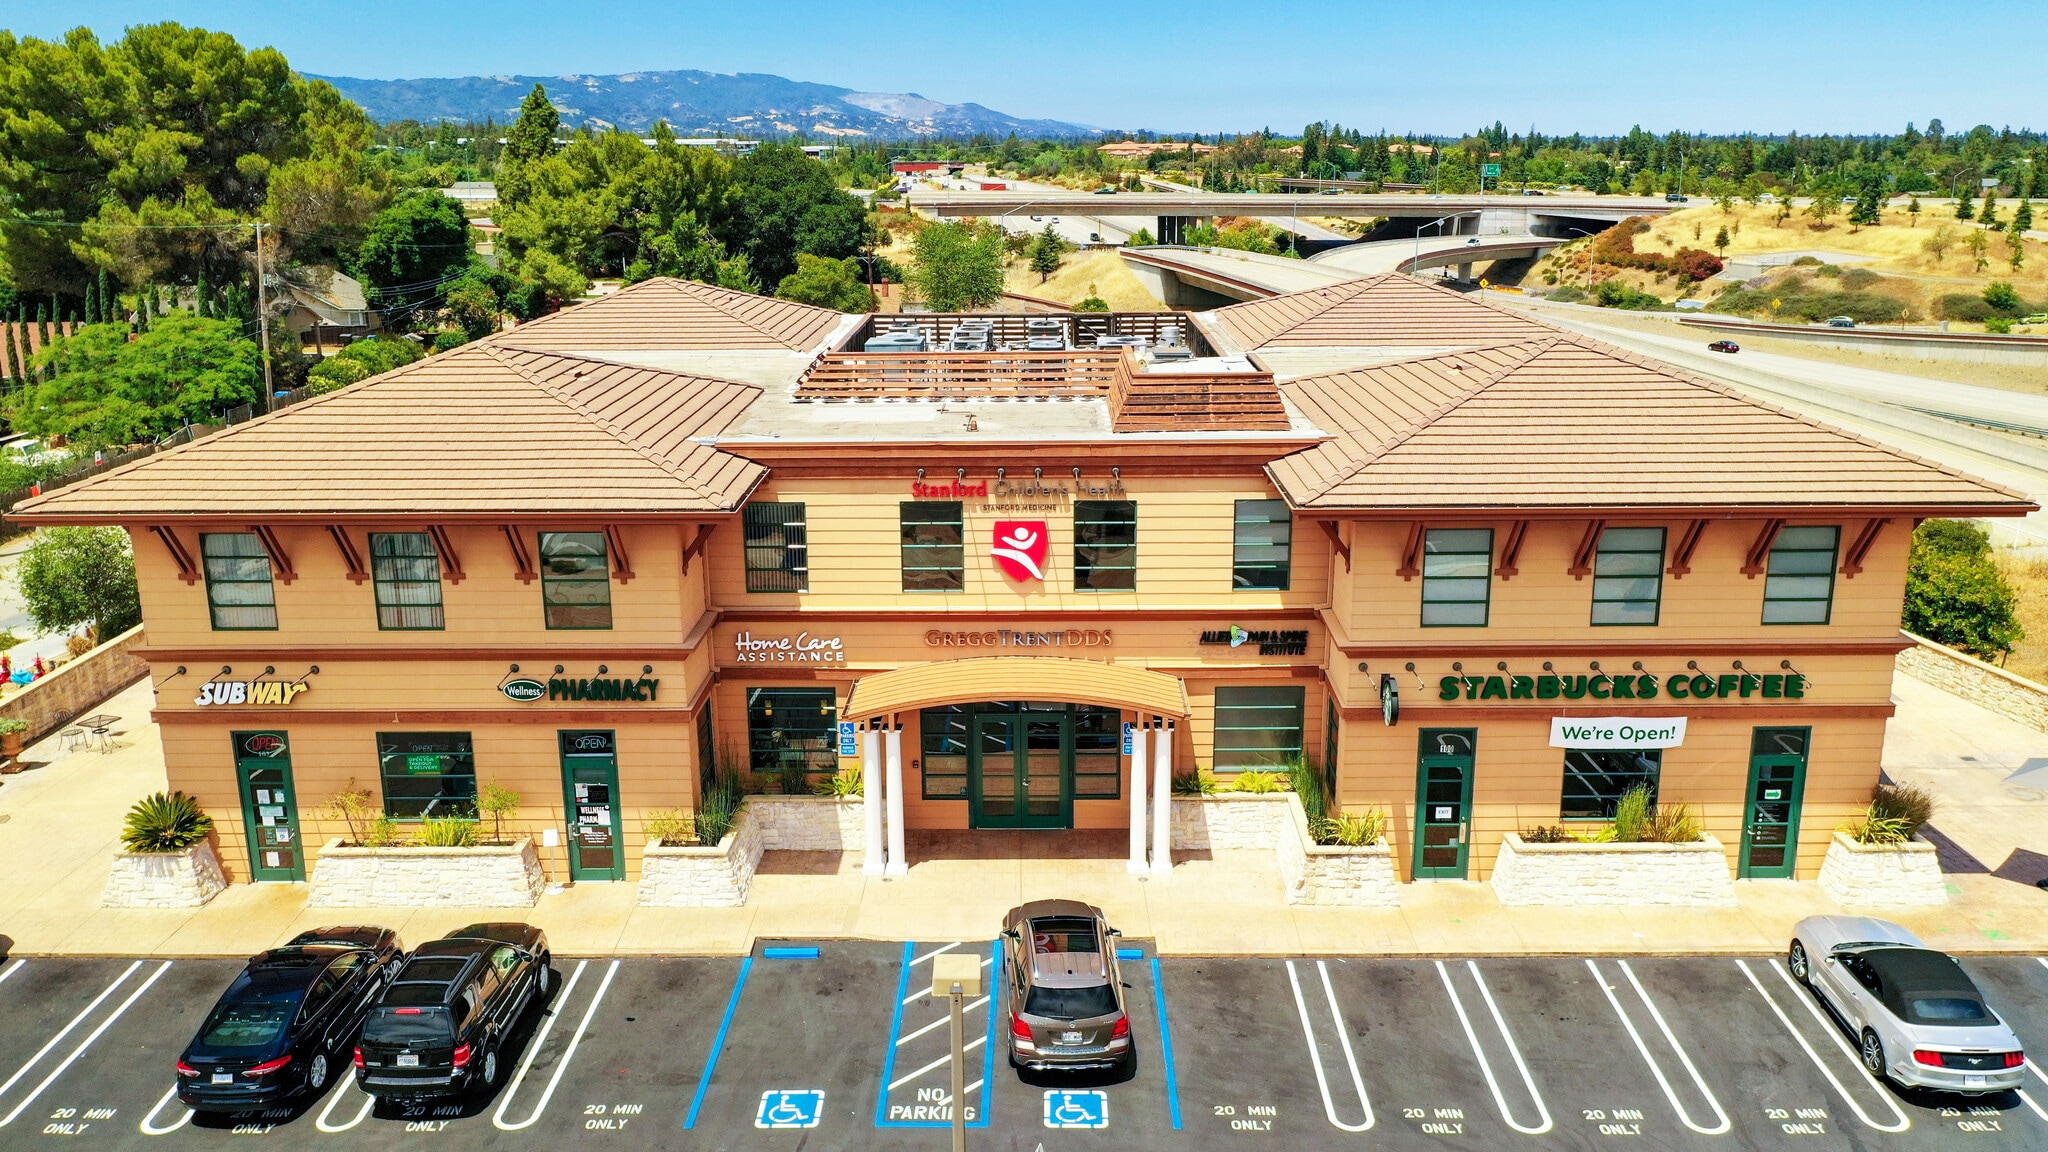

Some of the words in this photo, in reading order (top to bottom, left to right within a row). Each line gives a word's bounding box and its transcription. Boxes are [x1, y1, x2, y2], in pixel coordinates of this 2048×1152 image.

[912, 480, 988, 497] Stanford
[994, 480, 1068, 497] Children's
[1076, 480, 1127, 497] Health
[983, 504, 1020, 512] STANFORD
[1021, 504, 1057, 512] MEDICINE
[735, 631, 792, 650] Home
[796, 631, 843, 650] Care
[1280, 631, 1308, 643] SPINE
[1259, 643, 1307, 655] INSTITUTE
[737, 652, 844, 662] ASSISTANCE
[507, 685, 541, 696] Wellness
[549, 678, 659, 701] PHARMACY
[1439, 675, 1659, 700] STARBUCKS
[1666, 674, 1806, 699] COFFEE
[194, 681, 309, 706] SUBWAY
[1619, 726, 1676, 743] Open!
[252, 737, 281, 750] OPEN
[575, 738, 606, 749] OPEN
[917, 1088, 945, 1102] NO
[50, 1108, 77, 1118] 20
[83, 1108, 117, 1119] MIN
[403, 1106, 426, 1116] 20
[432, 1106, 463, 1116] MIN
[583, 1104, 606, 1115] 20
[613, 1104, 643, 1114] MIN
[1213, 1105, 1235, 1115] 20
[1247, 1105, 1276, 1116] MIN
[1402, 1108, 1425, 1118] 20
[1433, 1108, 1464, 1119] MIN
[1582, 1109, 1606, 1120] 20
[1612, 1109, 1644, 1120] MIN
[1764, 1108, 1789, 1119] 20
[1794, 1108, 1828, 1119] MIN
[1936, 1106, 1961, 1117] 20
[1967, 1106, 2001, 1116] MIN
[43, 1123, 89, 1134] ONLY
[231, 1123, 276, 1134] ONLY
[405, 1121, 449, 1131] ONLY
[585, 1119, 628, 1129] ONLY
[1230, 1120, 1271, 1130] ONLY
[1421, 1123, 1462, 1134] ONLY
[1598, 1124, 1641, 1135] ONLY
[1781, 1123, 1825, 1134] ONLY
[1957, 1121, 2002, 1131] ONLY
